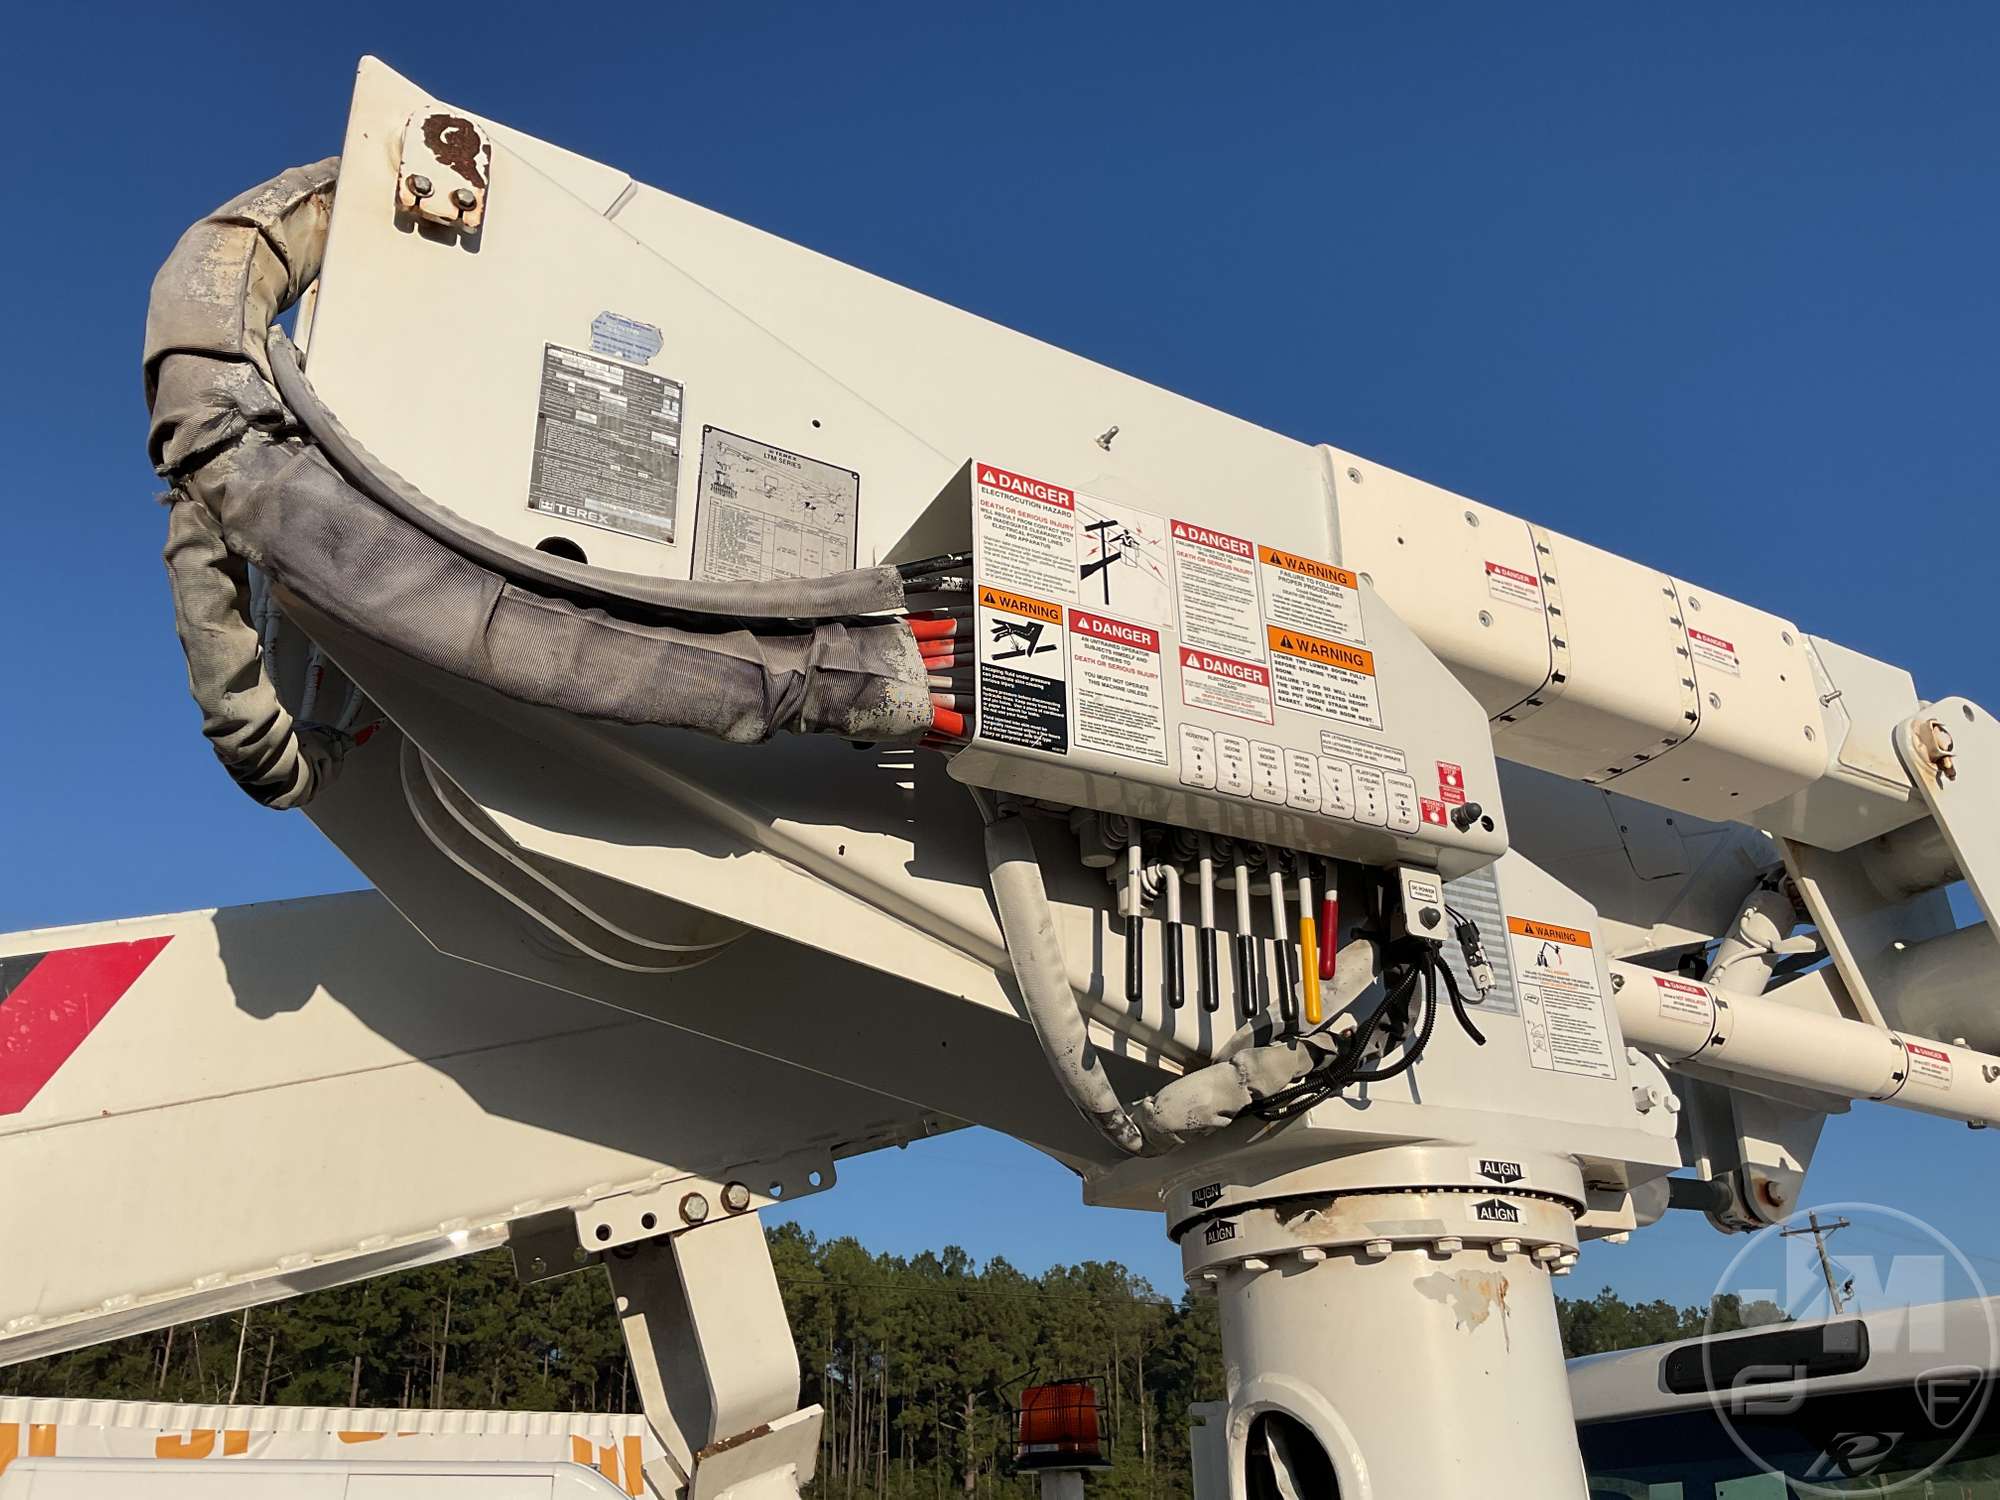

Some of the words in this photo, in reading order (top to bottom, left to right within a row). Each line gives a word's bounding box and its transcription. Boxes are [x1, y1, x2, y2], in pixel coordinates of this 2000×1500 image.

[764, 452, 777, 464] LTM
[778, 457, 802, 470] SERIES
[999, 474, 1069, 506] DANGER
[556, 502, 609, 524] TEREX
[981, 486, 1040, 509] ELECTROCUTION
[1042, 505, 1071, 518] HAZARD
[980, 499, 1003, 511] DEATH
[1005, 506, 1015, 514] OR
[1017, 509, 1047, 523] SERIOUS
[1049, 519, 1073, 530] INJURY
[1188, 528, 1250, 555] DANGER
[1279, 569, 1304, 581] FAILURE
[1315, 580, 1339, 591] FOLLOW
[1285, 557, 1348, 584] WARNING
[1502, 568, 1530, 583] DANGER
[1278, 575, 1302, 586] PROPER
[1303, 582, 1343, 598] PROCEDURES
[999, 596, 1059, 619] WARNING
[1092, 620, 1152, 645] DANGER
[1702, 634, 1727, 649] DANGER
[1296, 638, 1364, 666] WARNING
[1203, 658, 1262, 682] DANGER
[1273, 652, 1292, 661] LOWER
[1309, 662, 1328, 670] LOWER
[1331, 667, 1346, 675] BOOM
[1349, 672, 1365, 680] FULLY
[1274, 659, 1295, 669] BEFORE
[1299, 666, 1323, 676] STOWING
[1340, 676, 1357, 684] UPPER
[1275, 674, 1298, 684] FAILURE
[1348, 692, 1365, 700] LEAVE
[1290, 684, 1303, 692] UNIT
[1306, 688, 1321, 696] OVER
[1324, 693, 1345, 702] STATED
[1348, 698, 1368, 708] HEIGHT
[1306, 695, 1324, 704] UNDUE
[1327, 701, 1348, 710] STRAIN
[1339, 710, 1355, 718] BOOM
[1536, 927, 1576, 942] WARNING
[1670, 982, 1698, 994] DANGER
[1484, 1162, 1519, 1176] ALIGN
[1194, 1185, 1218, 1202] ALIGN
[1480, 1208, 1516, 1221] ALIGN
[1208, 1226, 1233, 1243] ALIGN
